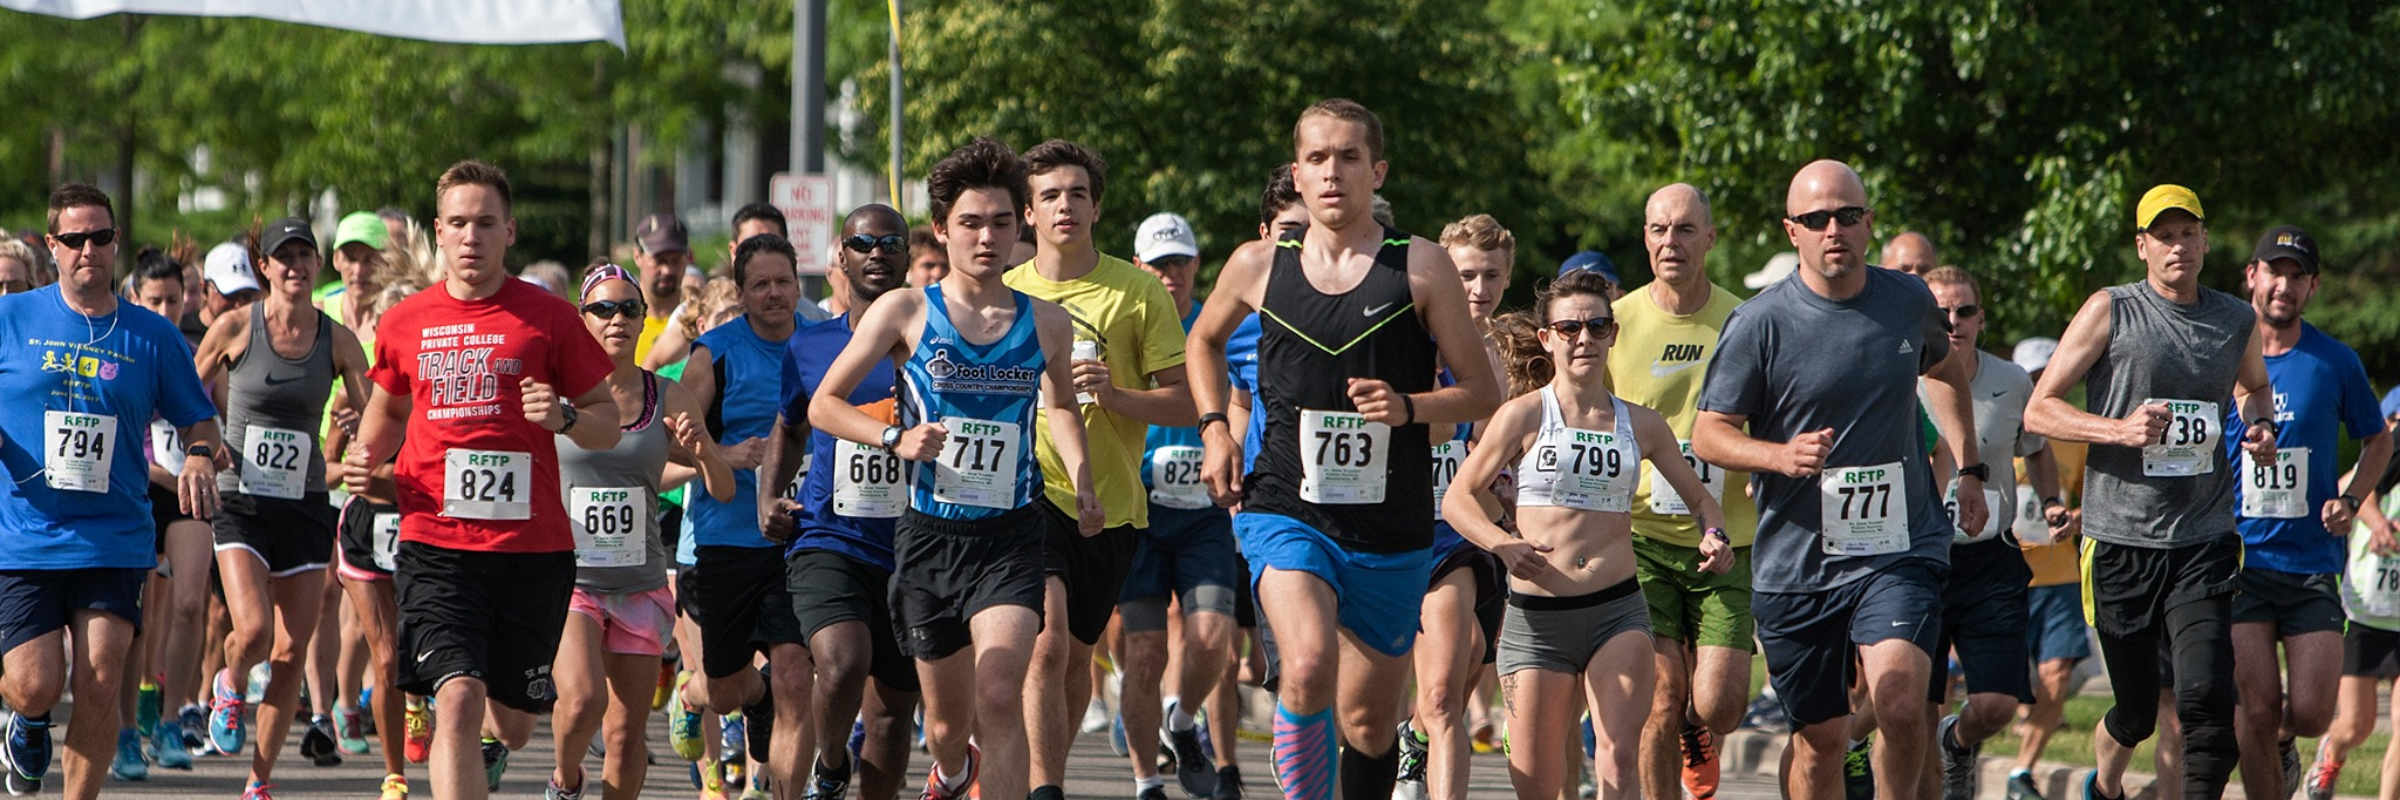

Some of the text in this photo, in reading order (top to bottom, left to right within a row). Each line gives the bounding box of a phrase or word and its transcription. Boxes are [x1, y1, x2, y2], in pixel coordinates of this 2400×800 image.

[792, 186, 812, 204] NO
[422, 323, 475, 338] WISCONSIN
[421, 333, 506, 350] PRIVATE COLLEGE
[1661, 344, 1705, 361] RUN
[417, 346, 522, 380] TRACK AND
[955, 363, 1035, 381] Foot Locker
[431, 373, 498, 406] FIELD
[933, 381, 1032, 393] CROSS COUNTRY CHAMPIONSHIPS
[427, 404, 501, 420] CHAMPIONSHIPS
[64, 415, 100, 428] RFTP
[962, 422, 1001, 436] RFTP
[1324, 415, 1367, 429] RFTP
[58, 428, 104, 461] 794
[264, 430, 296, 442] RFTP
[1576, 431, 1614, 444] RFTP
[256, 442, 299, 471] 822
[953, 436, 1005, 472] 717
[1171, 450, 1202, 459] RFTP
[1315, 431, 1372, 468] 763
[469, 454, 510, 467] RFTP
[850, 454, 900, 484] 668
[1571, 443, 1621, 478] 799
[1165, 460, 1202, 486] 825
[1846, 469, 1886, 483] RFTP
[2254, 464, 2298, 490] 819
[461, 469, 515, 502] 824
[591, 491, 629, 502] RFTP
[1839, 483, 1891, 520] 777
[585, 504, 634, 535] 669
